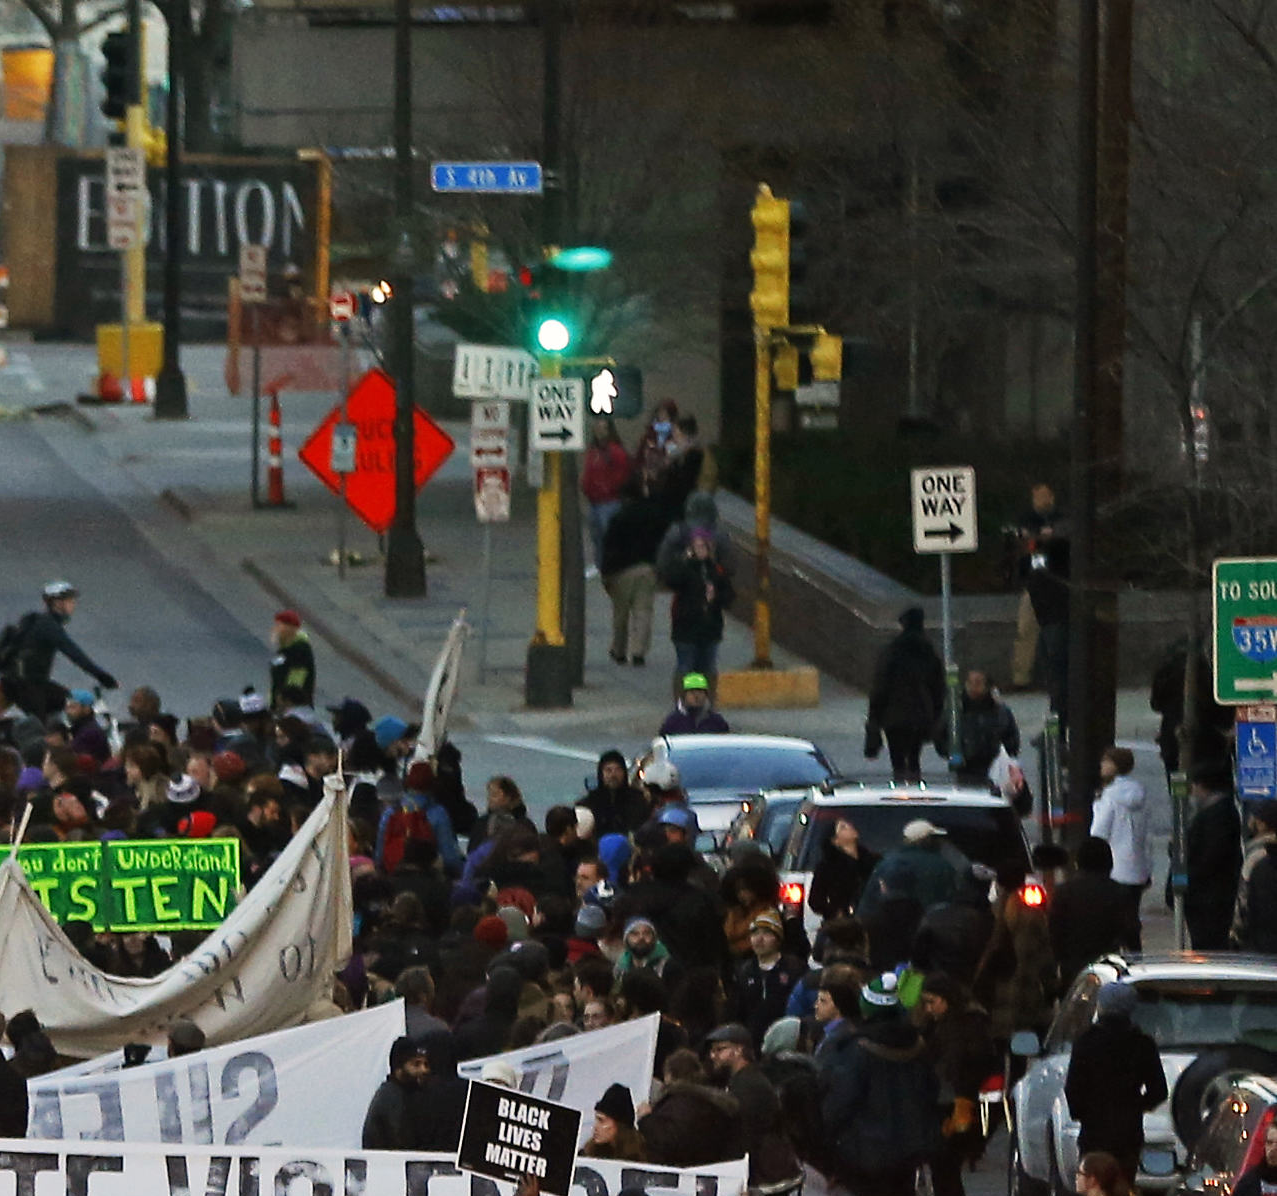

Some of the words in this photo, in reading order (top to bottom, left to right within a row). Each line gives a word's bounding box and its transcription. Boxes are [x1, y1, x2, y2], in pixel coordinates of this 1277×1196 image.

[446, 166, 457, 187] S
[539, 385, 575, 401] ONE
[538, 403, 574, 421] WAY
[922, 476, 966, 494] ONE
[921, 496, 966, 516] WAY
[1219, 581, 1241, 600] TO
[19, 854, 43, 874] ou
[32, 875, 229, 923] ISTEN
[497, 1096, 551, 1131] BLACK
[498, 1121, 543, 1152] LIVES
[485, 1142, 548, 1178] MATTER
